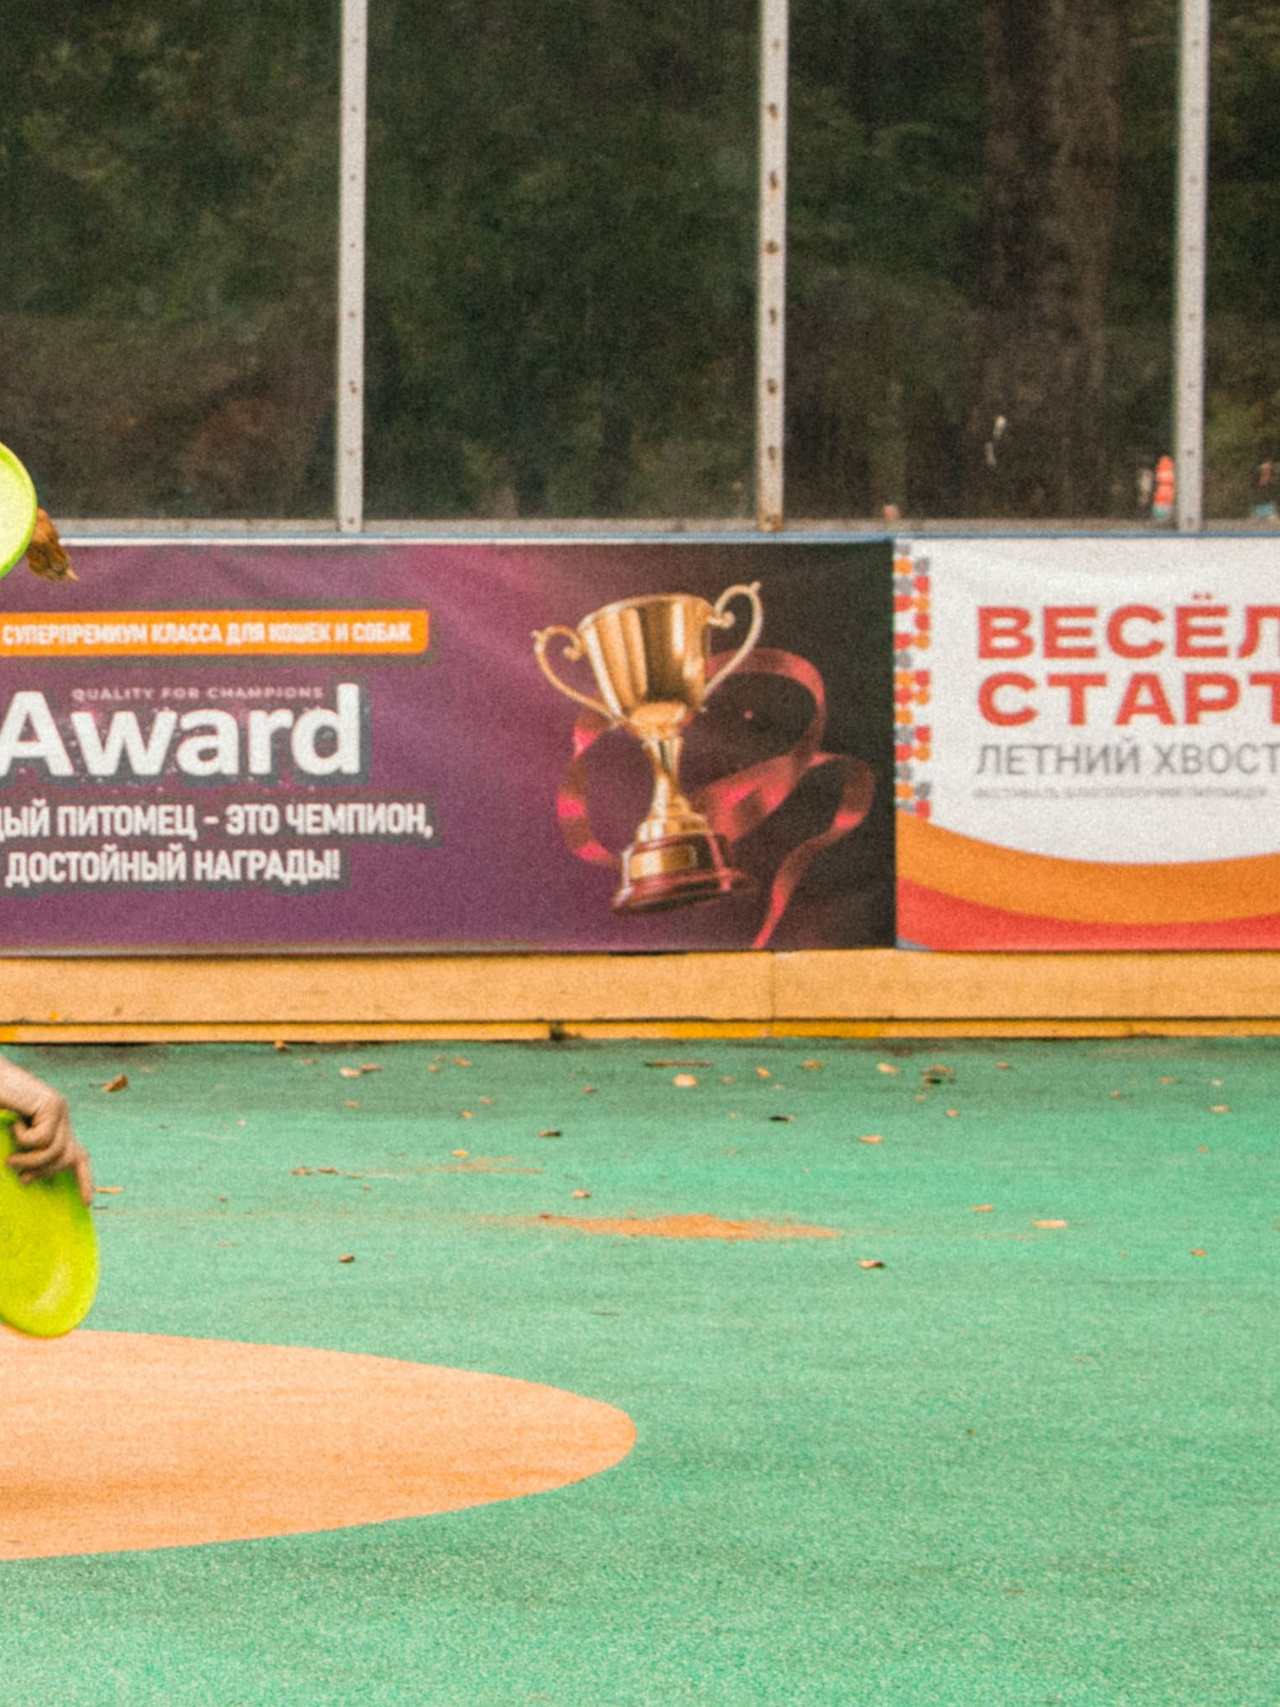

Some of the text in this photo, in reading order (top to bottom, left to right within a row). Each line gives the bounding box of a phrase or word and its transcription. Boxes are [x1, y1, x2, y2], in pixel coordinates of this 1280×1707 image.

[2, 623, 149, 645] СУПЕРПРЕМИУМ
[151, 622, 220, 644] КЛАССА
[225, 622, 265, 646] ДЛЯ
[269, 622, 331, 643] КОШЕК
[335, 622, 349, 642] И
[352, 622, 412, 642] СОБАК
[71, 686, 325, 701] QUALITY FOR CHAMPIONS
[976, 736, 1280, 775] ЛЕТНИЙ ХВОСТ
[56, 804, 199, 841] ПИТОМЕЦ
[224, 803, 280, 836] ЭТО
[285, 803, 434, 840] ЧЕМПИОН,
[4, 843, 341, 888] ДОСТОЙНЫЙ НАГРАДЫ!
